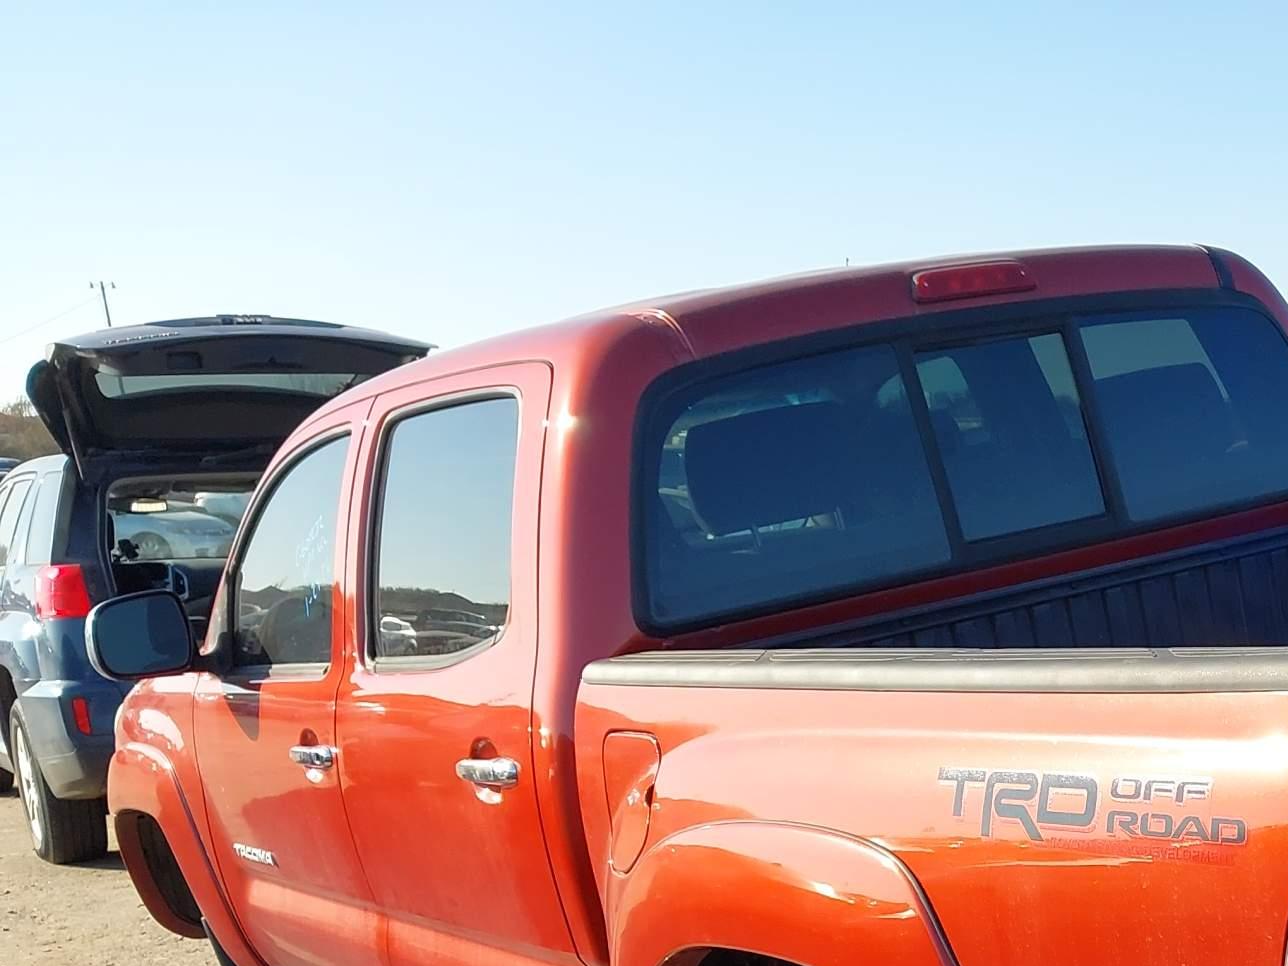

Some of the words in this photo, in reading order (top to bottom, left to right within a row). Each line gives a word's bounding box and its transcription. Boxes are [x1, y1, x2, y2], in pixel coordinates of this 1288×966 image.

[937, 766, 1099, 842] TRD
[1109, 777, 1213, 804] OFF
[1105, 809, 1248, 845] ROAD
